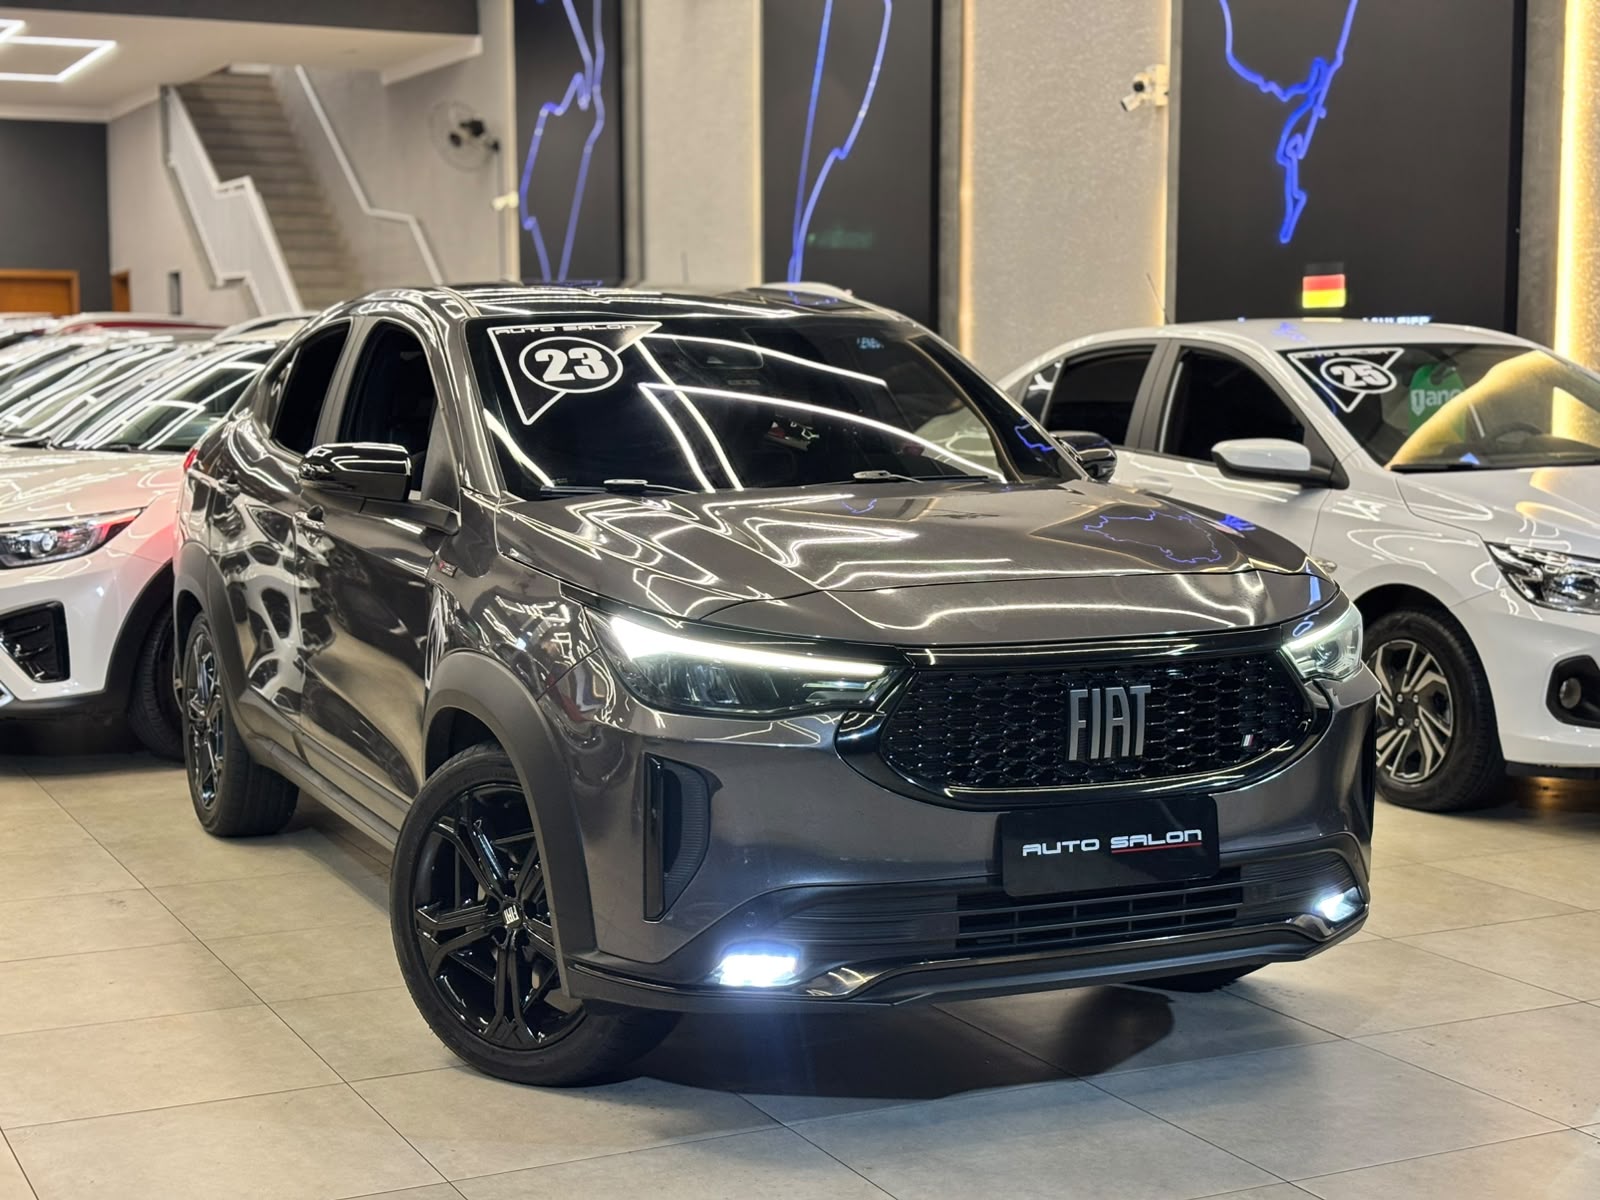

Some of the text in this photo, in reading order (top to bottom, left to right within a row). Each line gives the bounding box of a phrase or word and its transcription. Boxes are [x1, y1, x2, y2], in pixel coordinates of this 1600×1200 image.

[534, 347, 610, 382] 23
[1329, 364, 1390, 387] 25
[1068, 684, 1151, 761] FIAT
[1022, 828, 1203, 857] AUTO SALON
